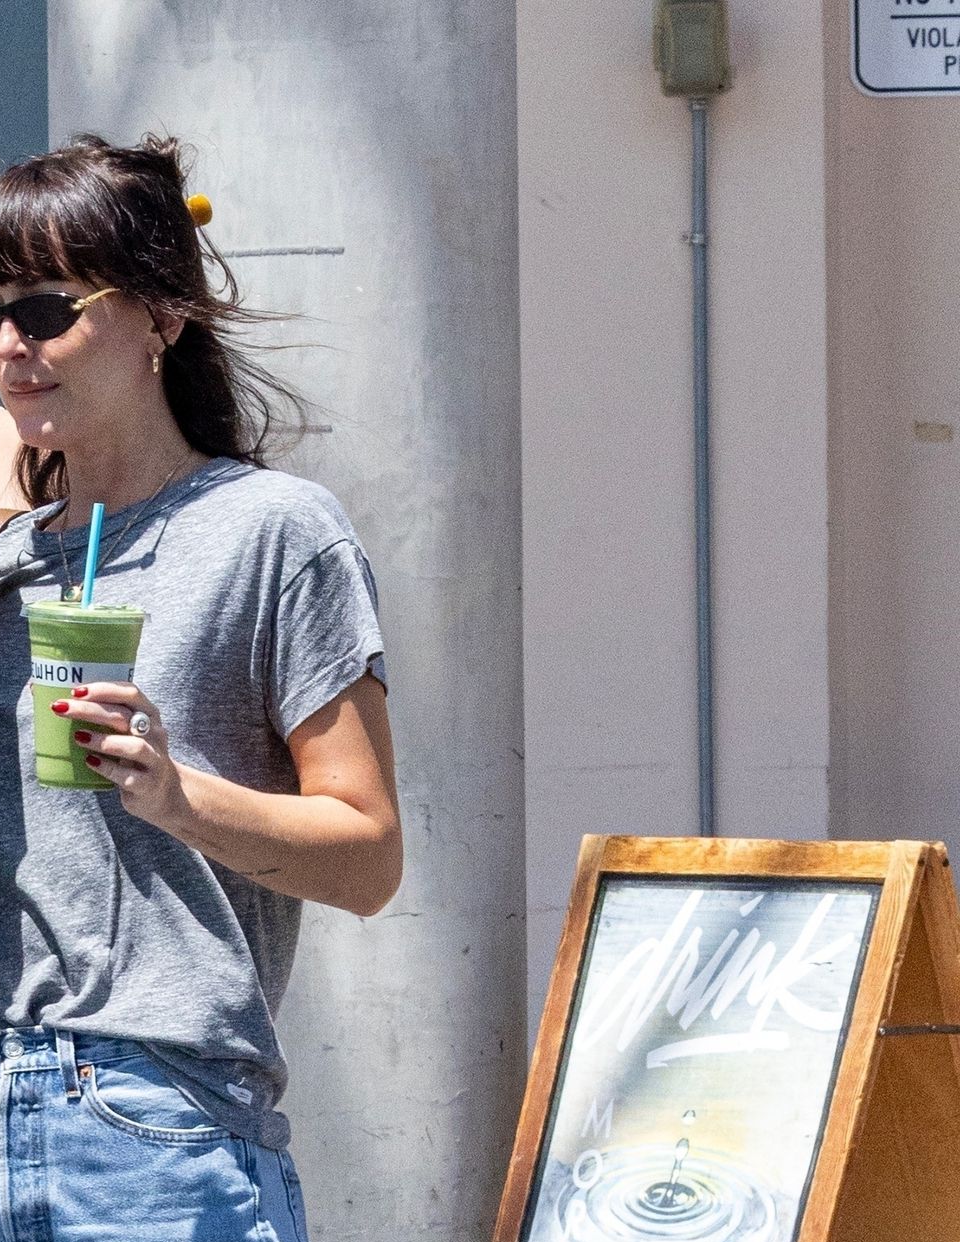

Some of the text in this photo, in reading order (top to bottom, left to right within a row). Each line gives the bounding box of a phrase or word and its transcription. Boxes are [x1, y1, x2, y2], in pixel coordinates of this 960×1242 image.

[907, 27, 960, 48] VIOL
[31, 662, 83, 683] WHON
[572, 890, 861, 1053] drink
